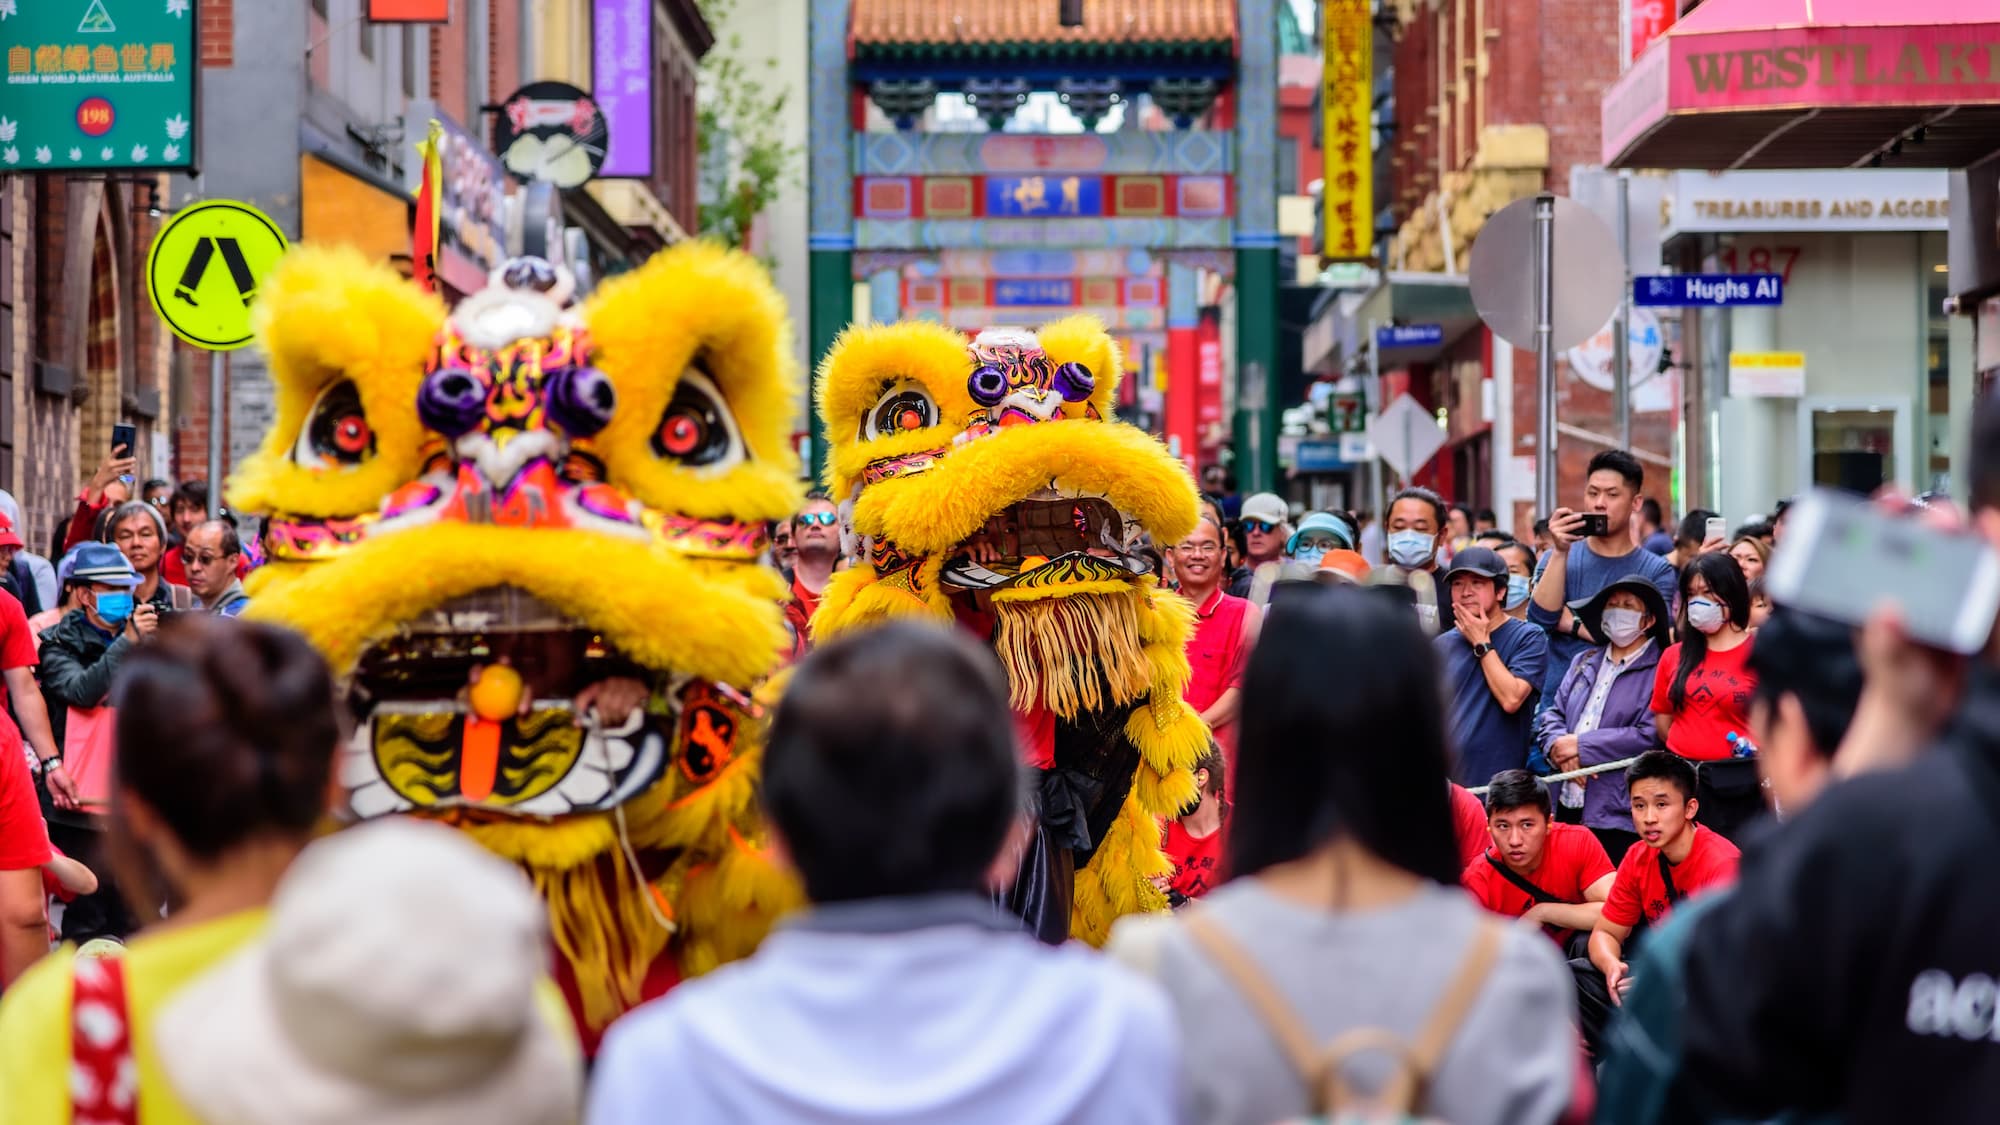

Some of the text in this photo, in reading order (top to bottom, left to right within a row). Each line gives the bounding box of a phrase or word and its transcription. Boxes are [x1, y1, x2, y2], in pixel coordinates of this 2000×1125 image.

[8, 72, 175, 84] GREEN WORLD NATURAL AUSTRALIA
[82, 108, 110, 125] 198
[1694, 200, 1822, 219] TREASURES
[1829, 199, 1873, 218] AND
[1723, 246, 1802, 284] 187
[1686, 278, 1750, 303] Hughs
